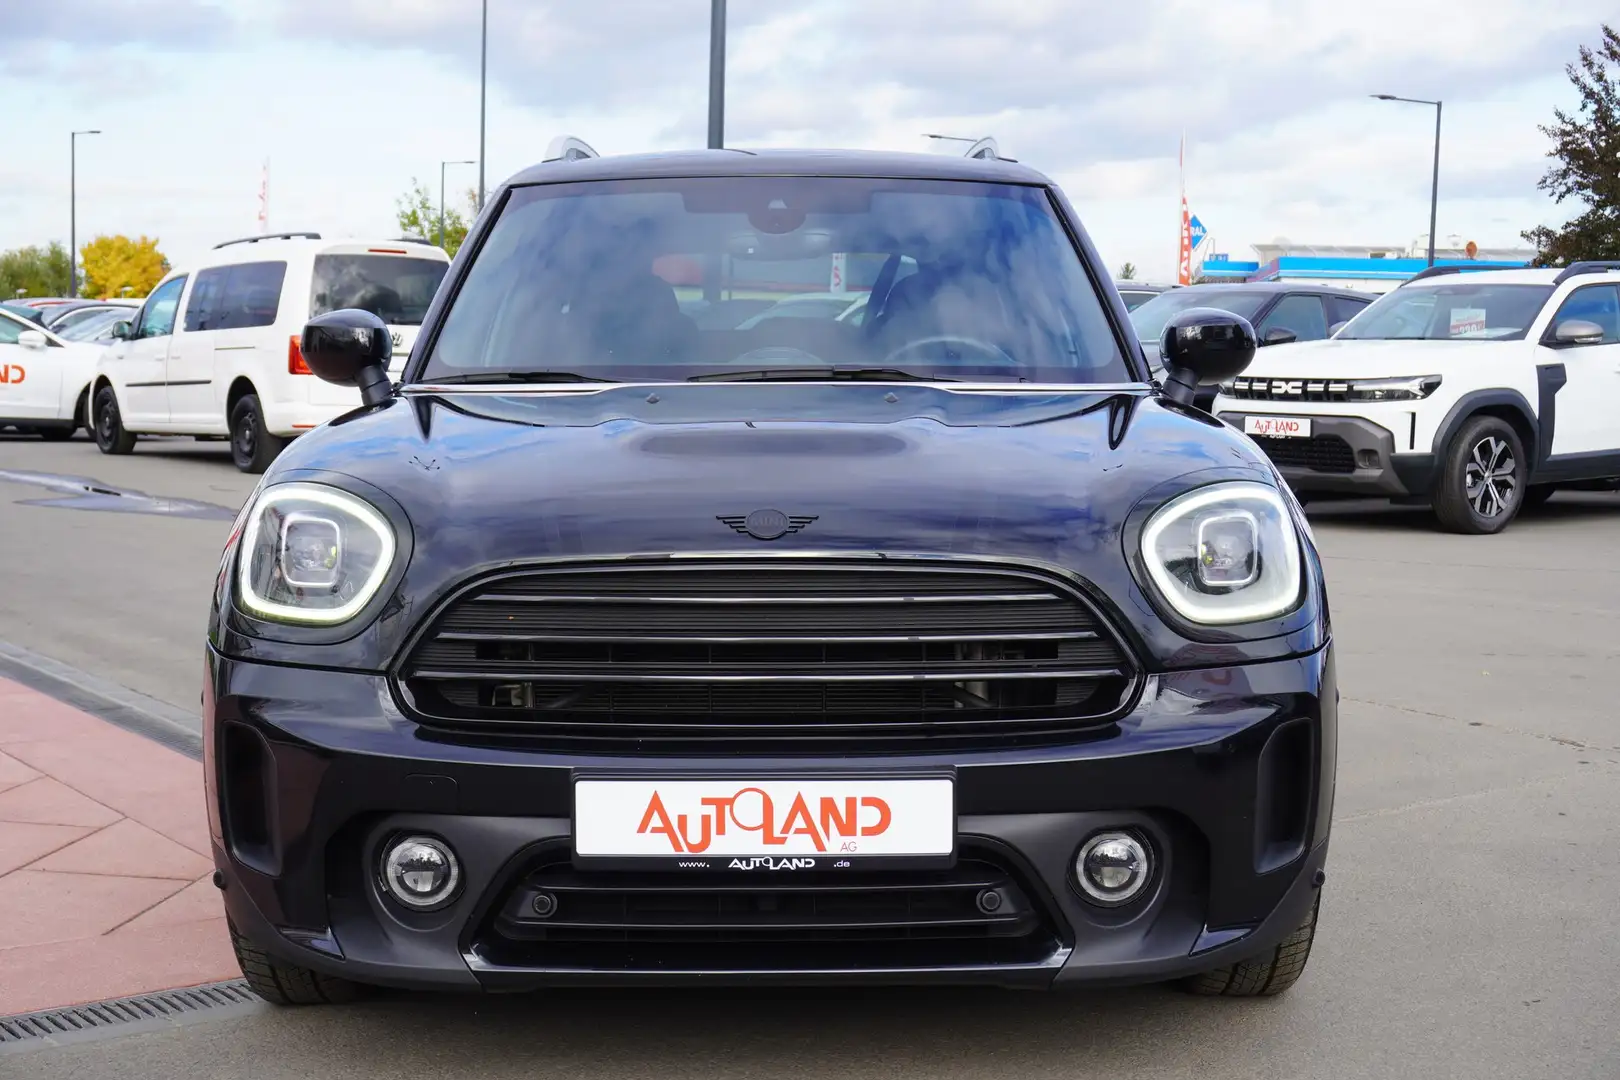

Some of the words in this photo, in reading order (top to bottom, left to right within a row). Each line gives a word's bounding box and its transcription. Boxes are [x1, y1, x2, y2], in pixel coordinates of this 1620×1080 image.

[1190, 226, 1205, 237] RAL
[636, 787, 892, 853] AUTOLAND
[840, 841, 858, 853] AG
[728, 856, 816, 871] AUTOLAND
[833, 859, 851, 868] .de
